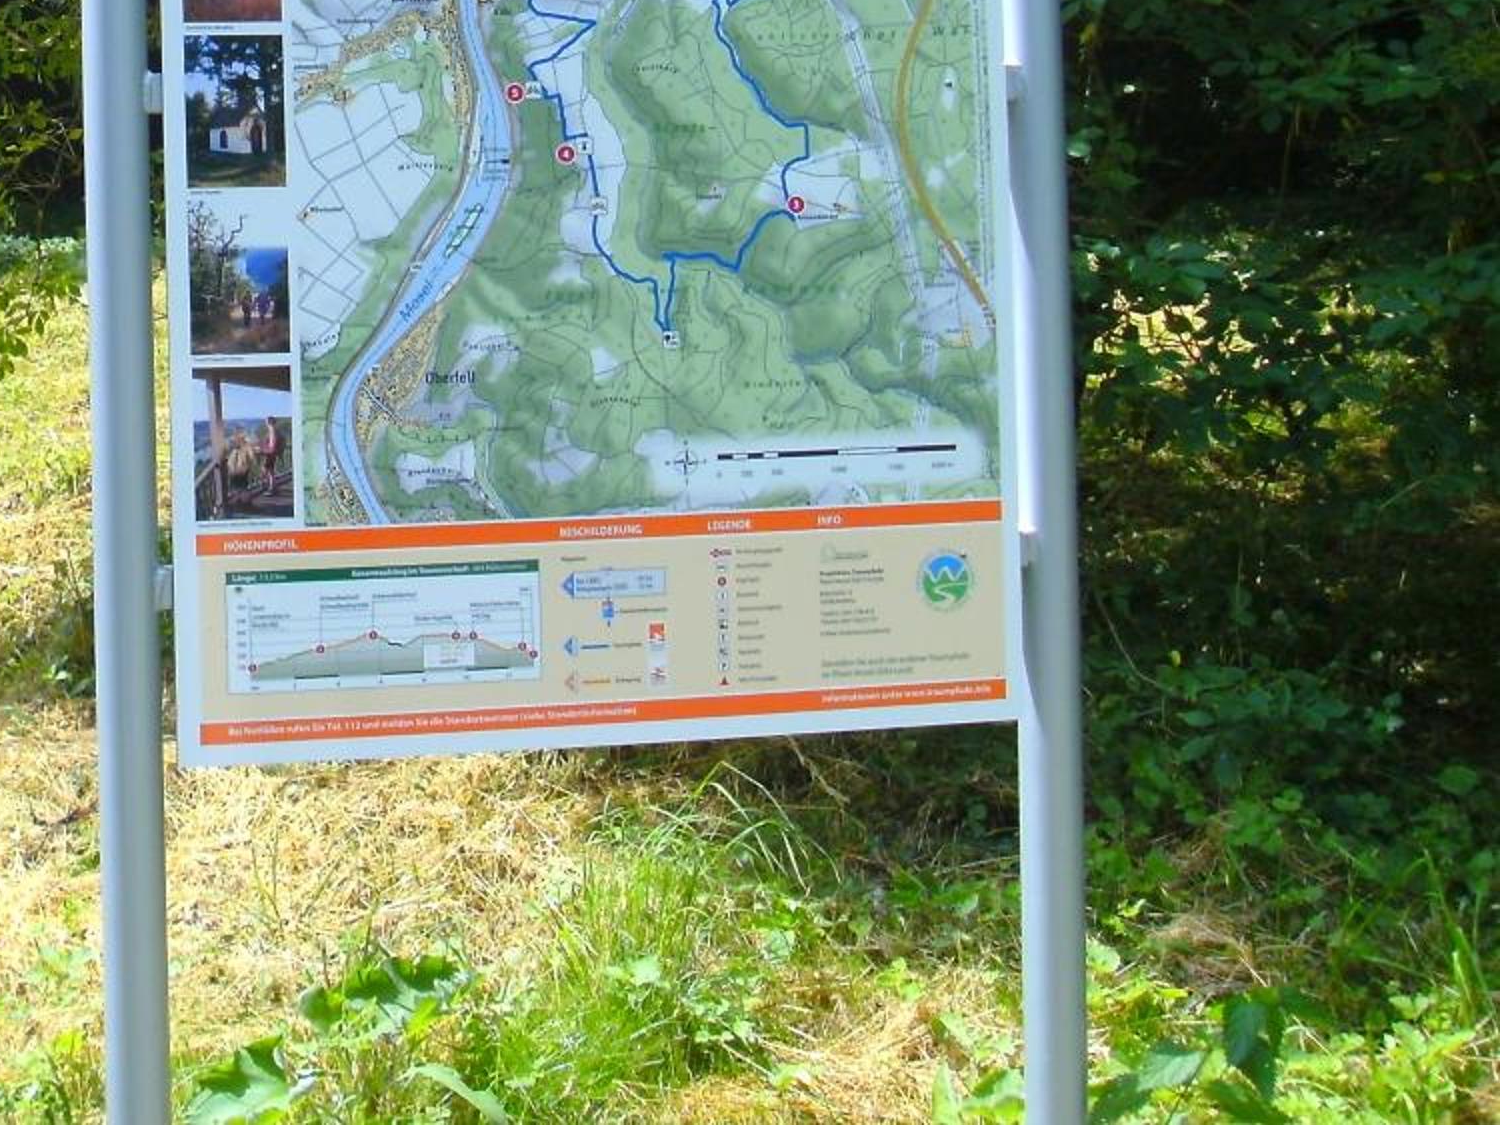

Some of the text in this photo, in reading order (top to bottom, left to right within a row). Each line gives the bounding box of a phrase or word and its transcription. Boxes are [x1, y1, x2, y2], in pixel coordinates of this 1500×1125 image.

[707, 519, 752, 532] LEGENDE
[817, 514, 842, 525] INFO
[560, 524, 643, 538] BESCHILDERUNG
